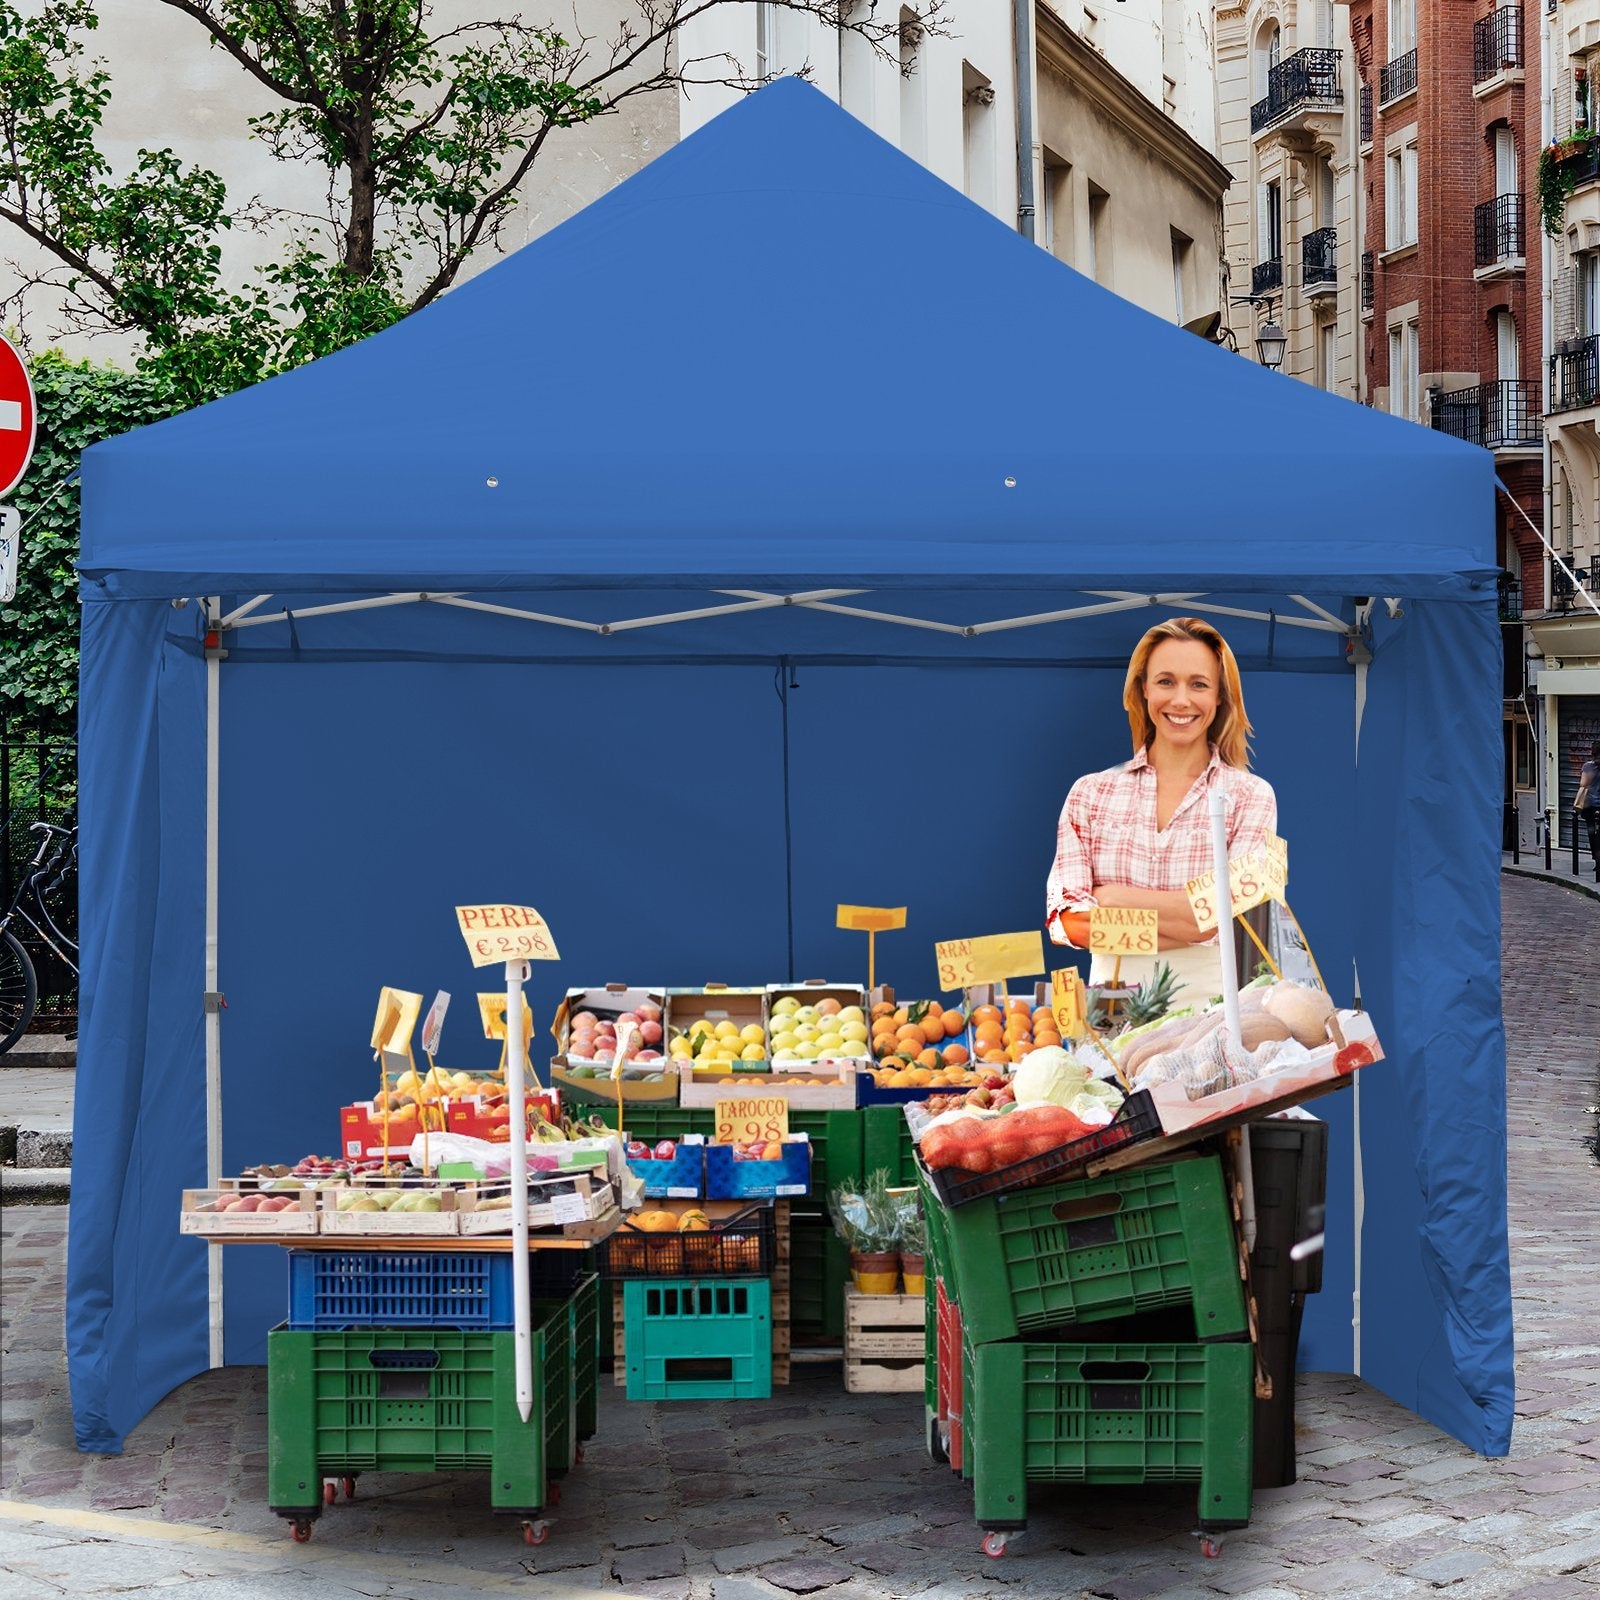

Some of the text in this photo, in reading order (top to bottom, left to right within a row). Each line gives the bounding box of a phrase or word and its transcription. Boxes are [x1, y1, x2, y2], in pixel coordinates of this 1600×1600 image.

[1187, 852, 1257, 895] PICNTE
[460, 906, 544, 929] PERE
[1093, 909, 1156, 926] ANANAS
[476, 932, 548, 956] € 2,98
[1091, 930, 1153, 951] 2,48
[718, 1099, 785, 1119] TAROCCO
